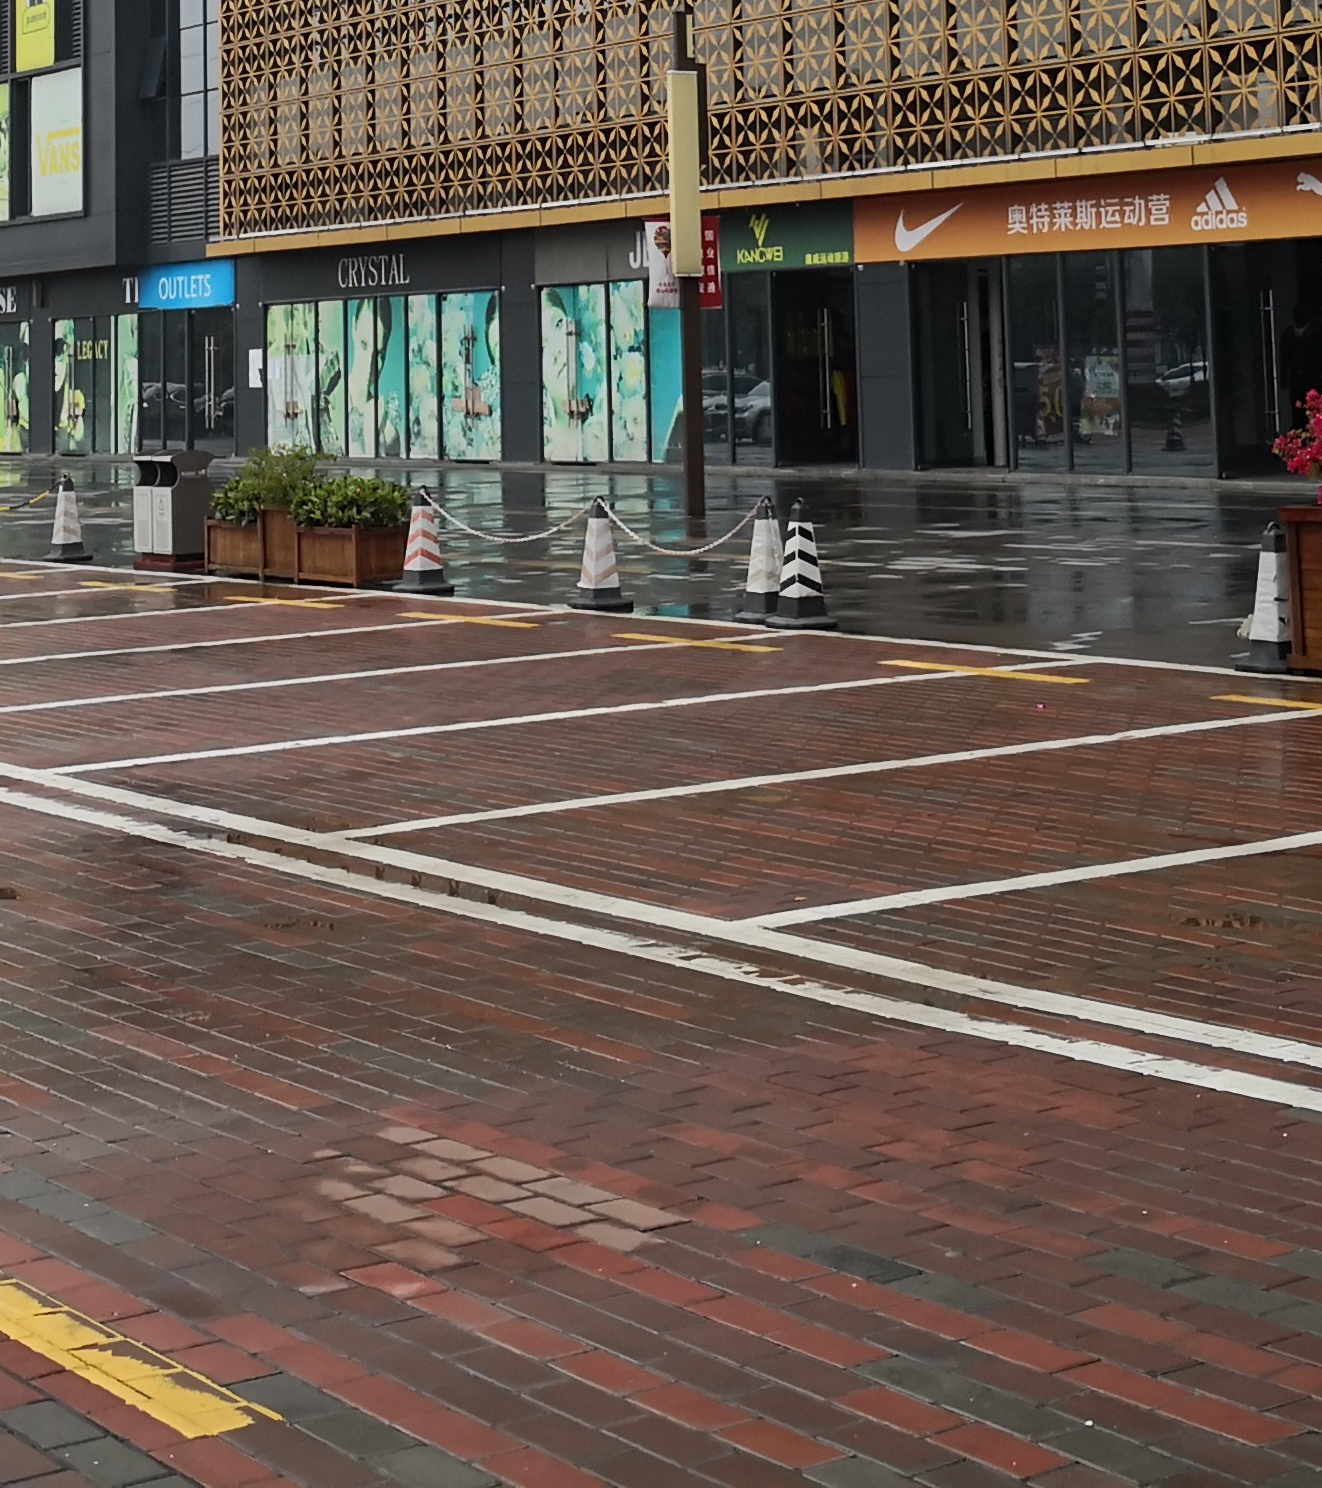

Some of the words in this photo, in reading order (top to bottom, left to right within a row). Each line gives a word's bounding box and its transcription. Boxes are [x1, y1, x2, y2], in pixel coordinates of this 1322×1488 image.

[1007, 193, 1171, 237] 奥特莱斯运动营
[1190, 210, 1248, 232] adidas
[337, 254, 410, 289] CRYSTAL
[158, 274, 212, 300] OUTLETS
